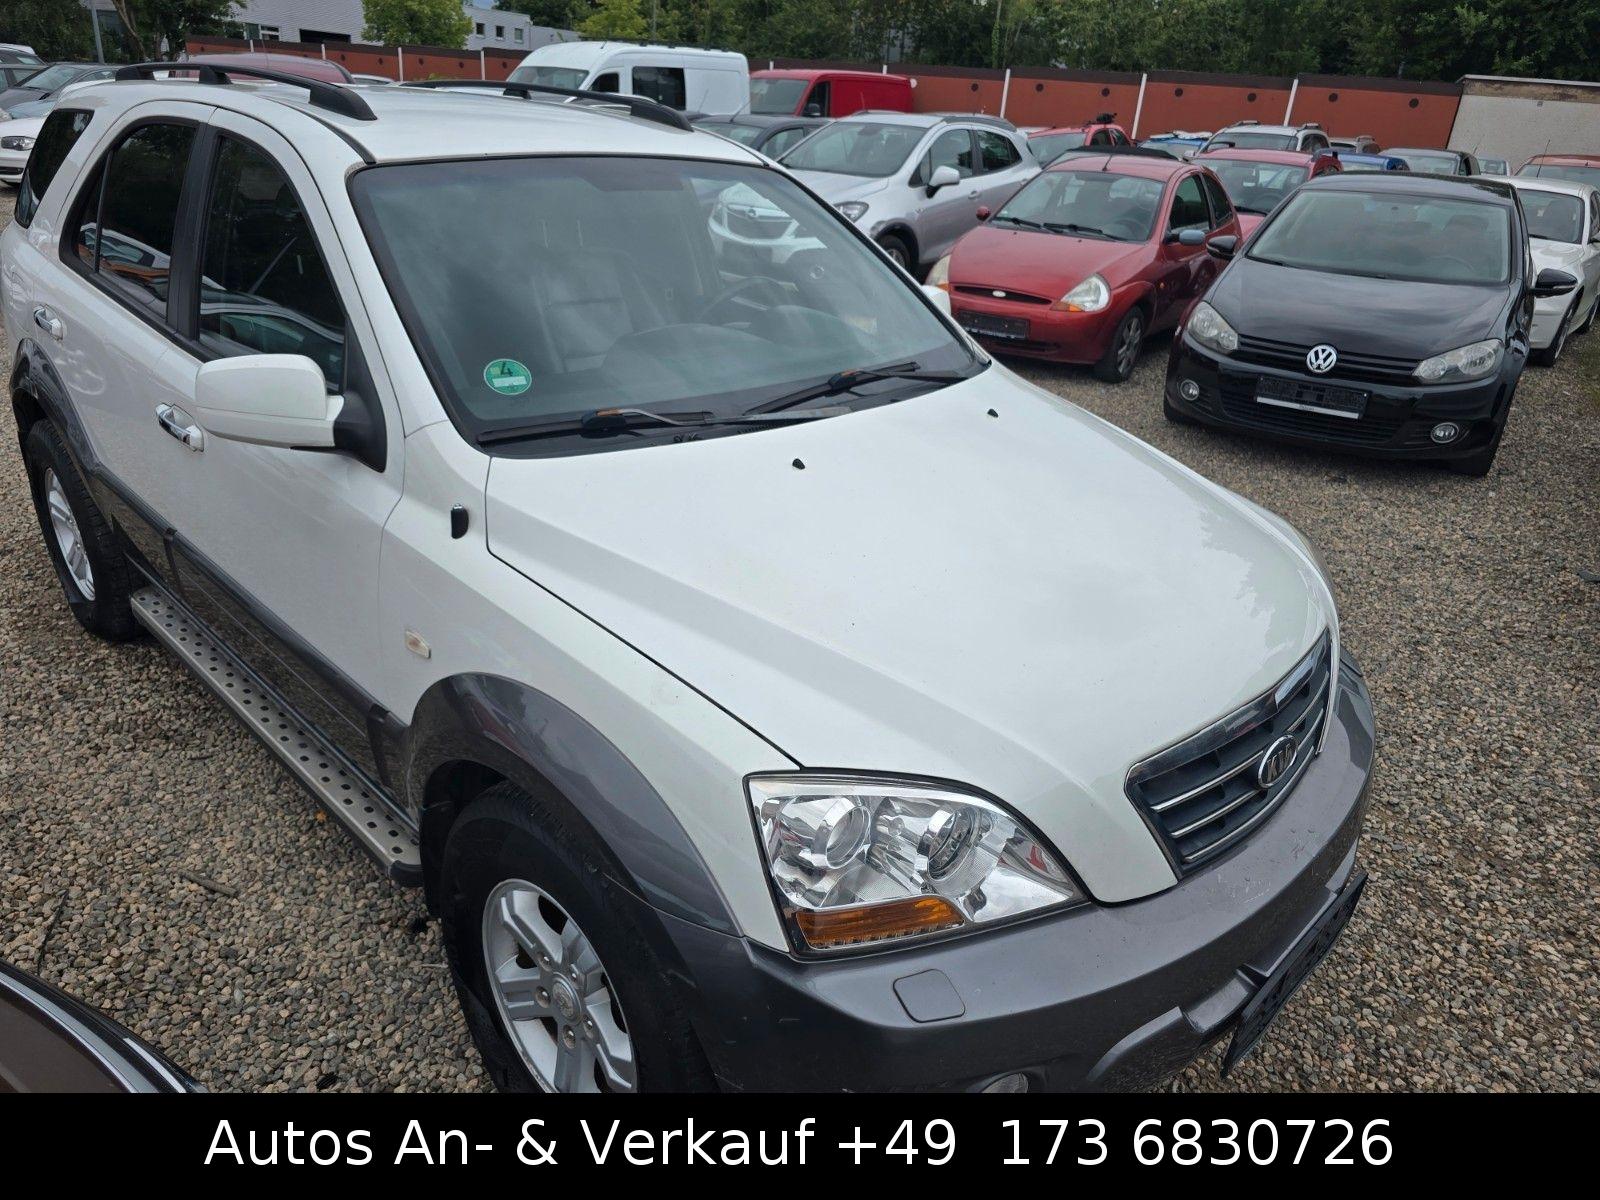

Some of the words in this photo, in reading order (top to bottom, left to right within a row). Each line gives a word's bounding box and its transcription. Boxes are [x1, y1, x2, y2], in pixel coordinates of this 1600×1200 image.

[500, 361, 513, 377] 4
[1308, 346, 1337, 373] VW
[1266, 743, 1294, 783] KIA
